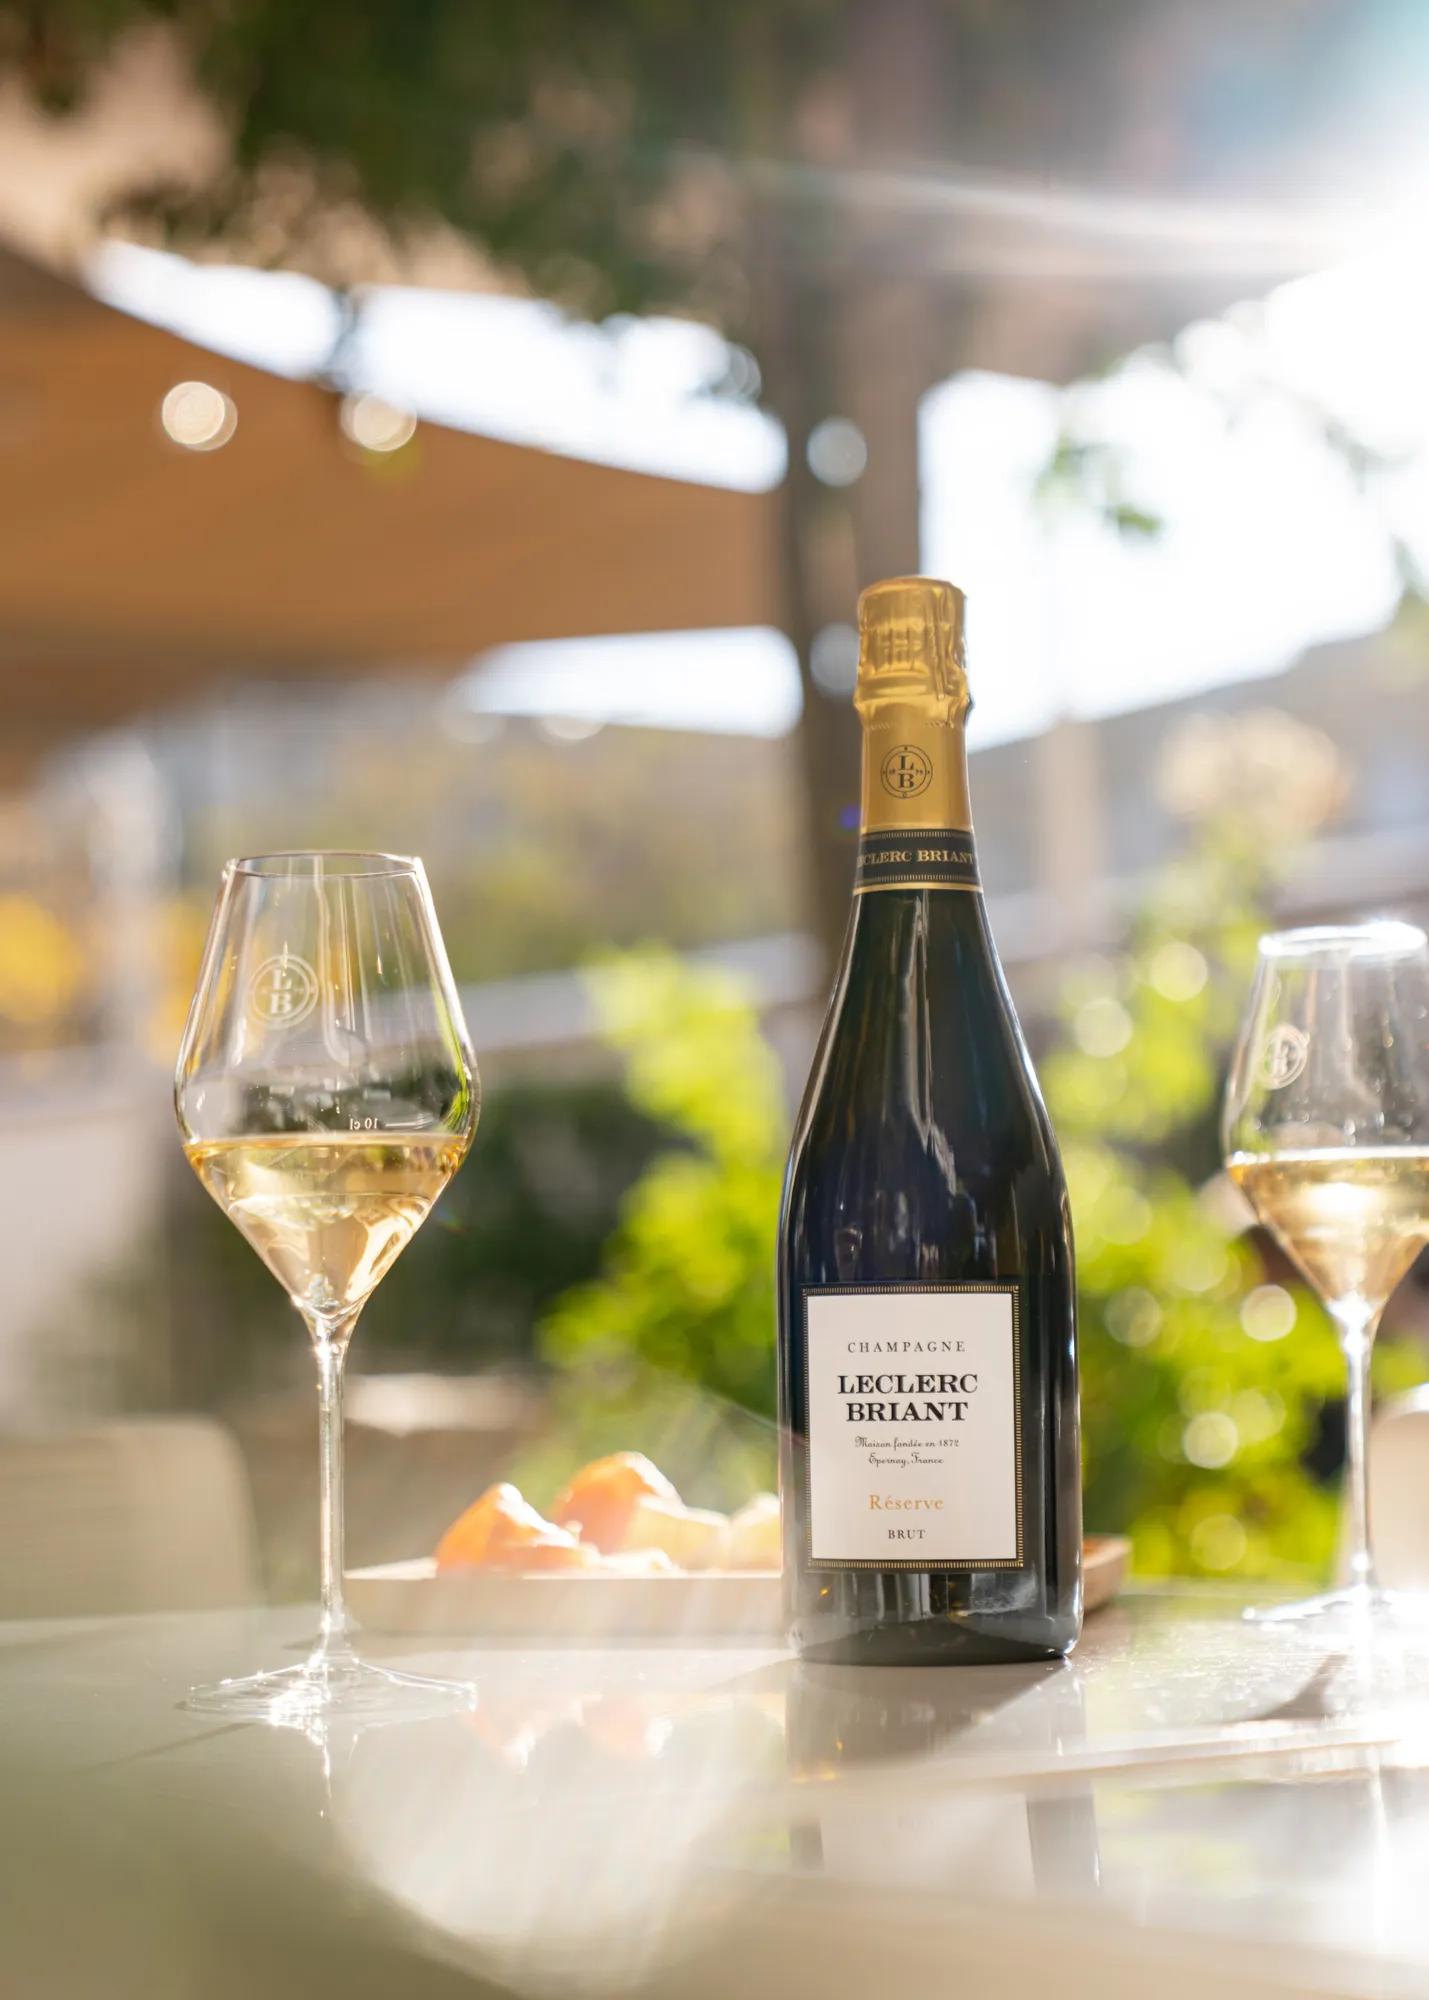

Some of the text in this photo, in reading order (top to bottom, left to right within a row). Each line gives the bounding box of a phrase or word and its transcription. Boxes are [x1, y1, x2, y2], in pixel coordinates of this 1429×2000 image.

[899, 754, 914, 770] L
[898, 773, 914, 788] B
[917, 849, 974, 864] BRIANT
[847, 1340, 966, 1353] CHAMPAGNE
[837, 1373, 978, 1395] LECLERC
[846, 1401, 969, 1422] BRIANT
[854, 1436, 891, 1448] Maison
[939, 1439, 960, 1447] 1872
[911, 1452, 944, 1464] France
[868, 1494, 944, 1510] Réserve
[888, 1529, 926, 1540] BRUT
